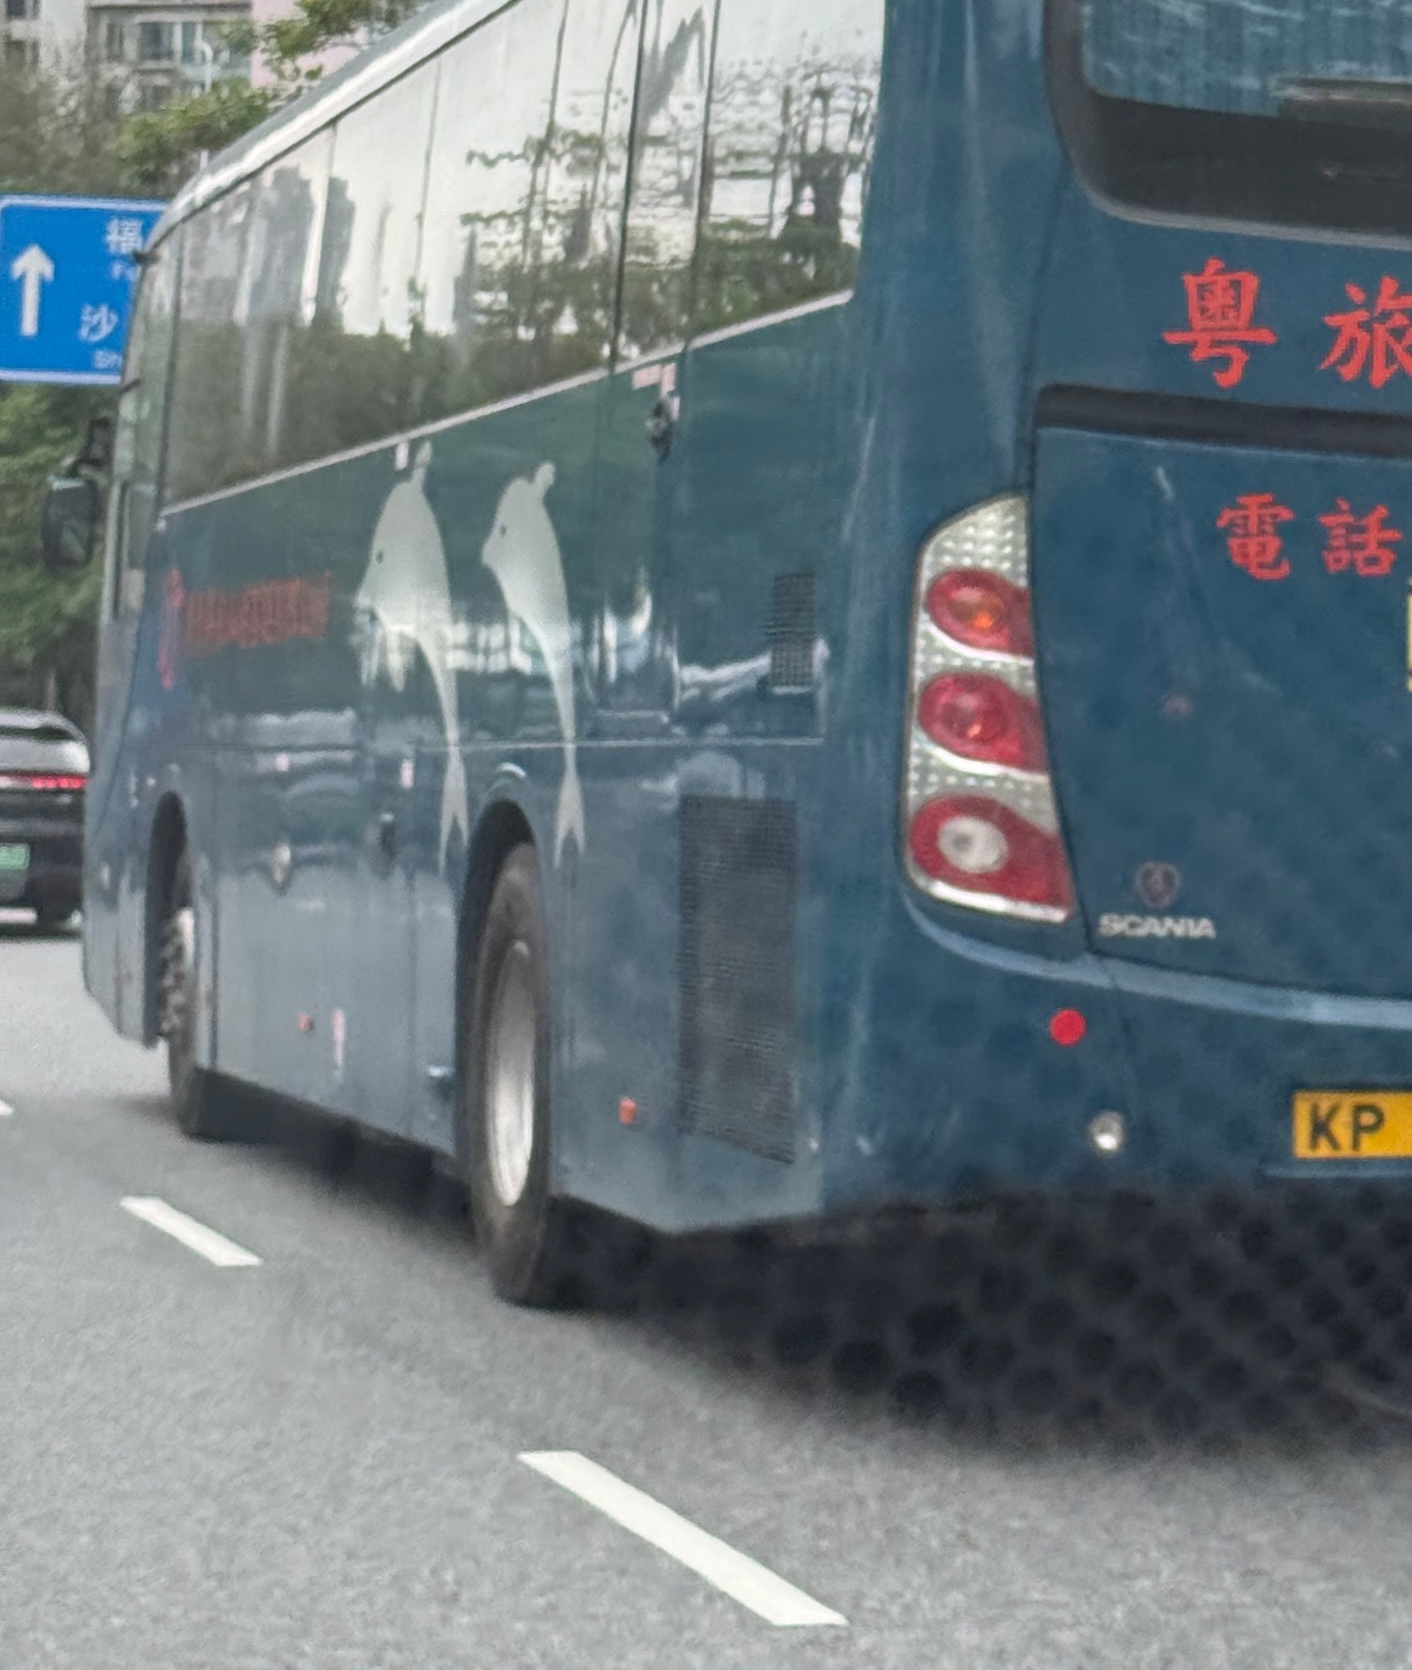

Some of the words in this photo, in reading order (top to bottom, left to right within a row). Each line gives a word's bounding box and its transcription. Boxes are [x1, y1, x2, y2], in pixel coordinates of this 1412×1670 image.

[79, 302, 119, 343] 沙
[1099, 912, 1217, 940] SCANIA
[1306, 1102, 1386, 1152] KP
